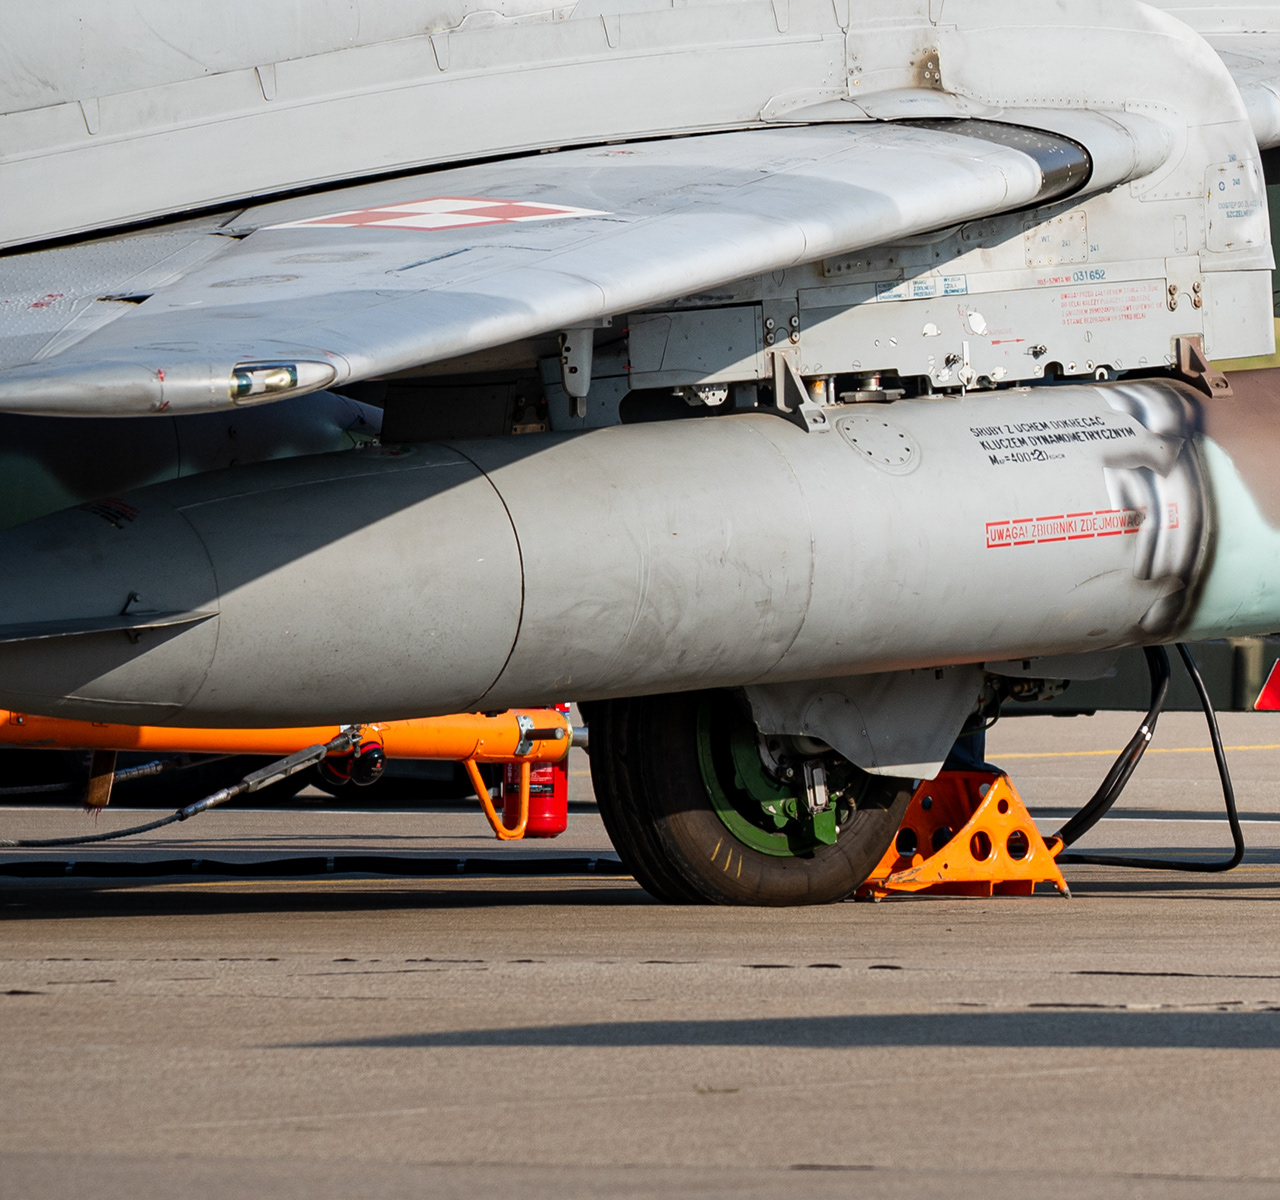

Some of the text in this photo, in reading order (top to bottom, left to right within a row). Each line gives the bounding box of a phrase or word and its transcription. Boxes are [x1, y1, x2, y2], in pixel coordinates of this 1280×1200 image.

[1090, 244, 1099, 253] 241
[1073, 269, 1106, 282] 031652
[1004, 425, 1014, 435] Z
[1013, 421, 1049, 434] UCHEM
[979, 427, 1136, 451] KLUCZEM DYNAMOMETRYCZNYM
[989, 524, 1028, 542] UWAGA!
[1031, 519, 1078, 537] ZBIORNIKI
